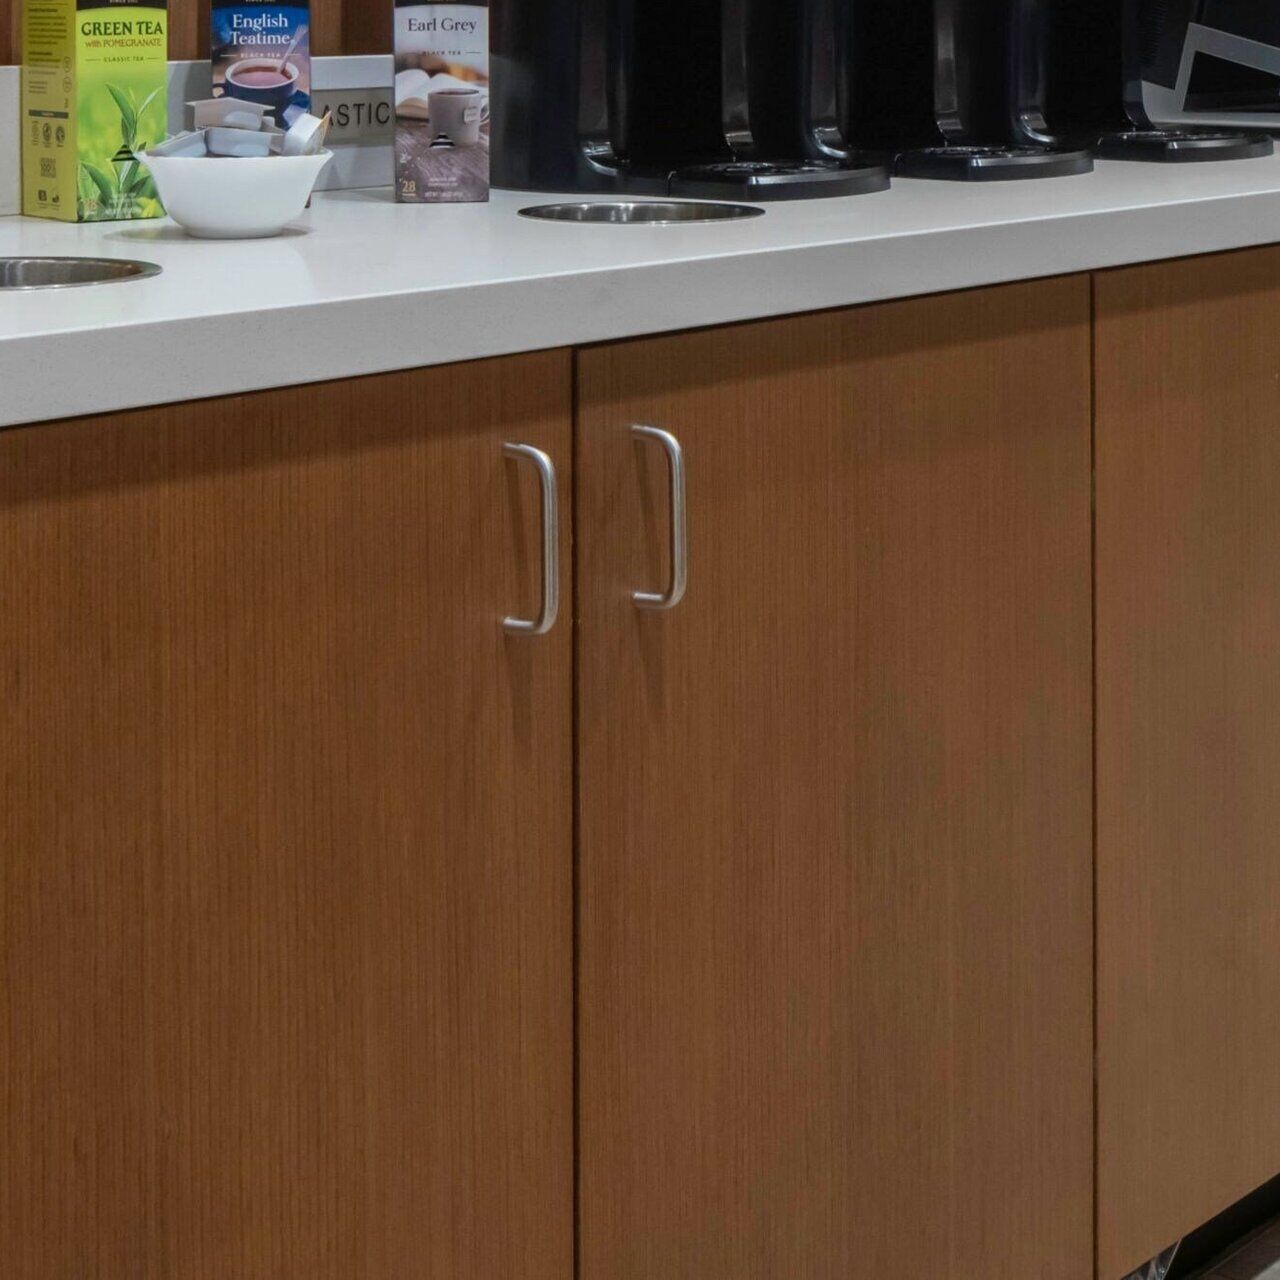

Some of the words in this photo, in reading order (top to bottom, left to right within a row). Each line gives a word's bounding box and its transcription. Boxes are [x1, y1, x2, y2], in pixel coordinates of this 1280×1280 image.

[81, 21, 132, 36] GREEN
[136, 21, 163, 36] TEA
[233, 13, 288, 31] English
[408, 18, 437, 32] Earl
[441, 18, 477, 34] Grey
[85, 39, 102, 48] with
[103, 38, 162, 48] POMEGRANATE
[230, 31, 290, 45] Teatime
[402, 180, 416, 192] 28
